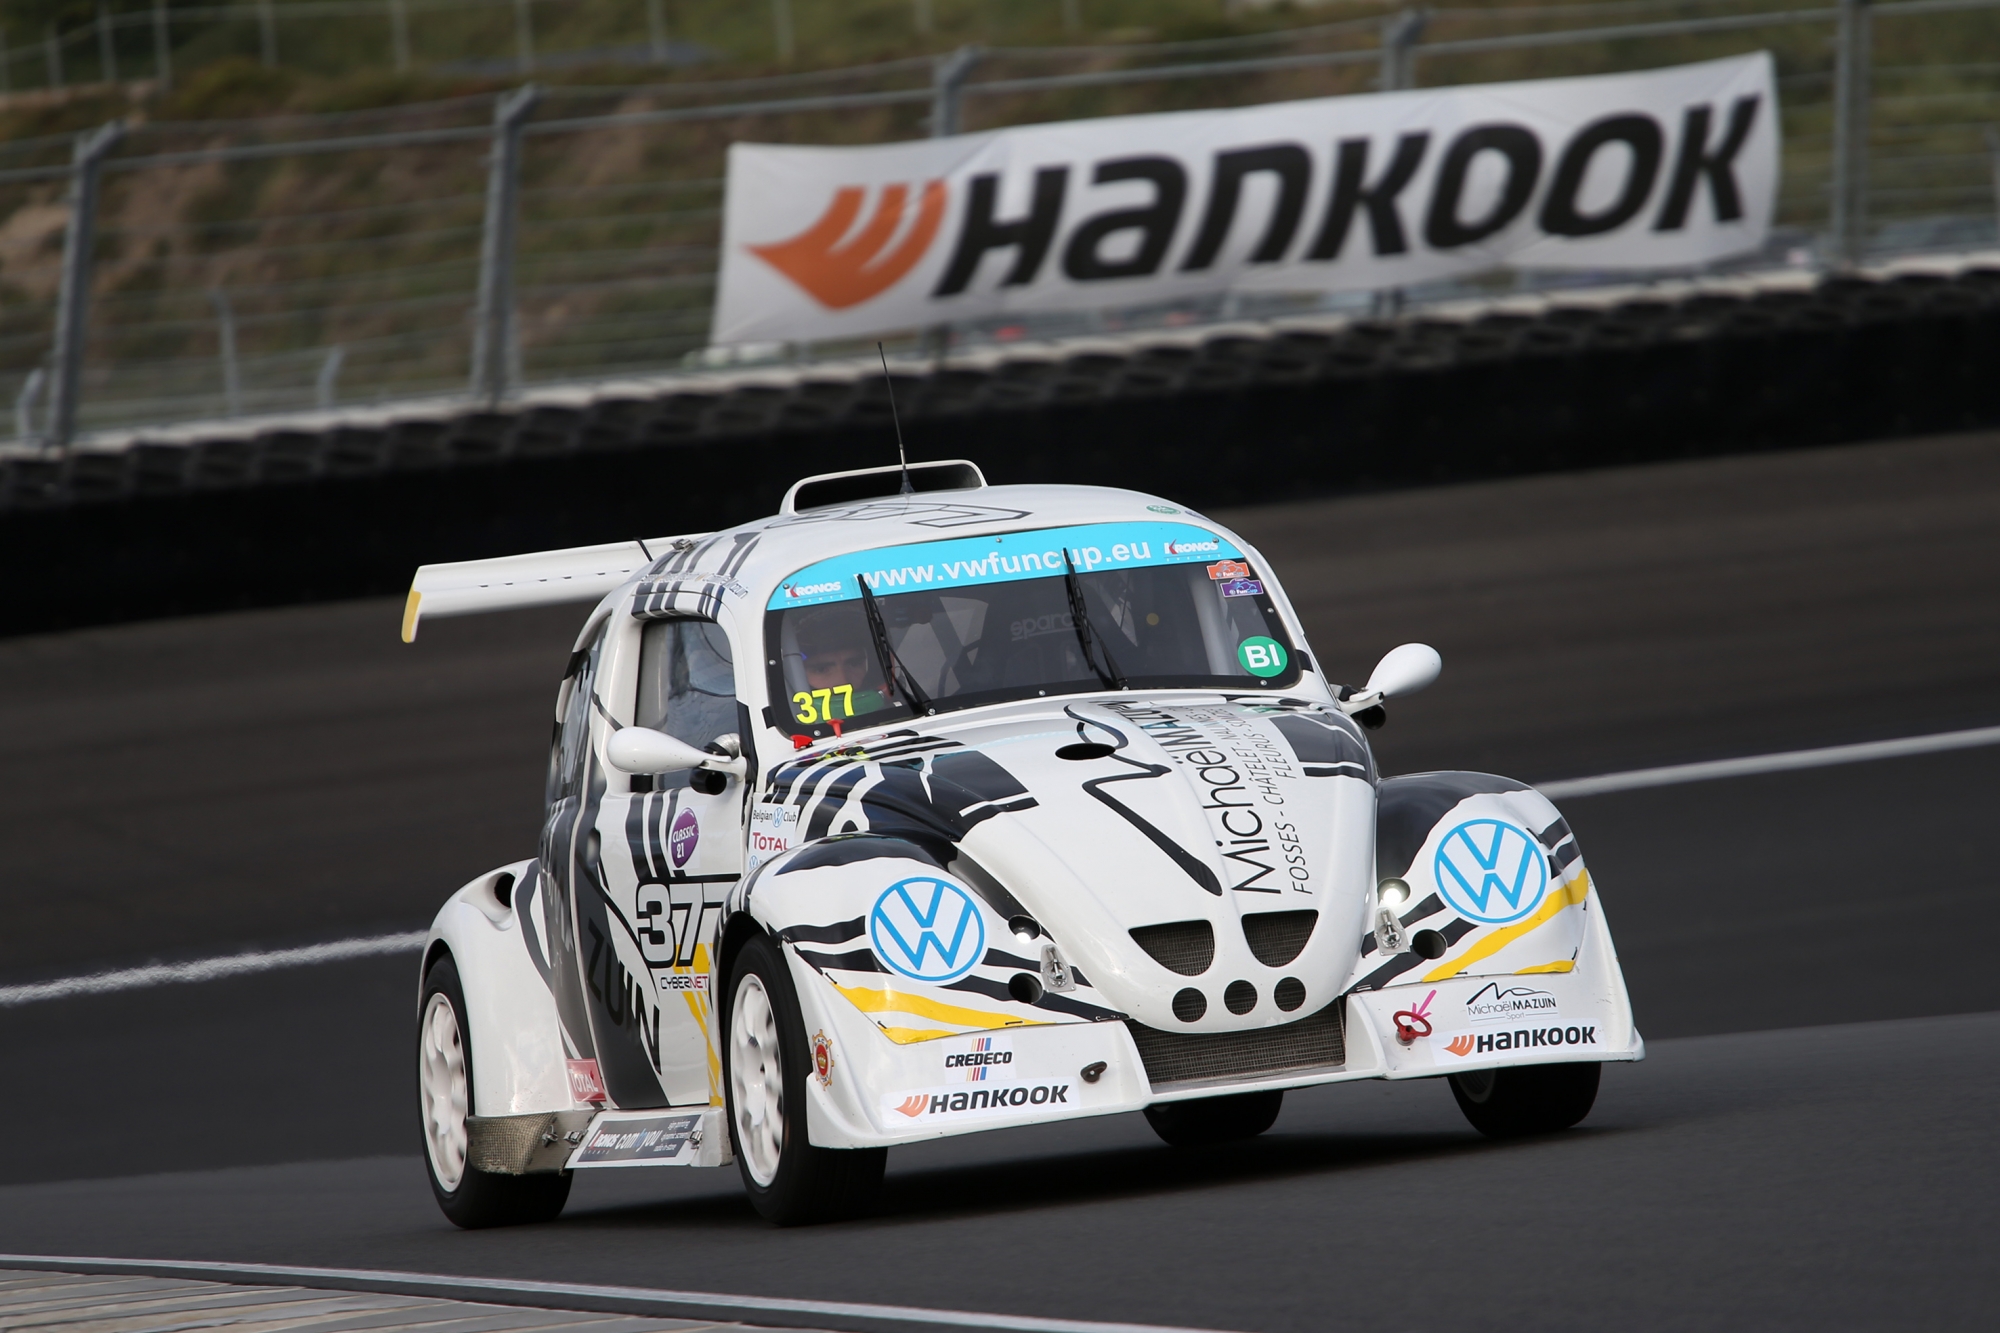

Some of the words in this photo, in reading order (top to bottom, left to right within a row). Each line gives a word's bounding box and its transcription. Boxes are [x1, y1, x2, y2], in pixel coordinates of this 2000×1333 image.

[932, 94, 1762, 299] HANKOOK
[1163, 540, 1219, 554] KRONOS
[853, 541, 1152, 588] www.vwfuncup.eu
[785, 582, 842, 598] KRONOS
[1010, 612, 1080, 640] sparc
[1244, 643, 1281, 668] BI
[792, 684, 854, 724] 377
[1243, 733, 1297, 779] FLEURUS
[753, 809, 773, 823] Belgian
[783, 811, 797, 822] Club
[672, 824, 696, 843] CLASSIC
[752, 832, 788, 851] TOTAL
[676, 842, 685, 859] 21
[1274, 822, 1313, 894] FOSSES
[660, 976, 708, 989] CYBERNET
[1505, 1012, 1525, 1021] Sport
[1476, 1026, 1596, 1053] HANKOOK
[945, 1051, 1013, 1068] CREDECO
[568, 1069, 599, 1093] TOTAL
[928, 1085, 1069, 1114] HANKOOK
